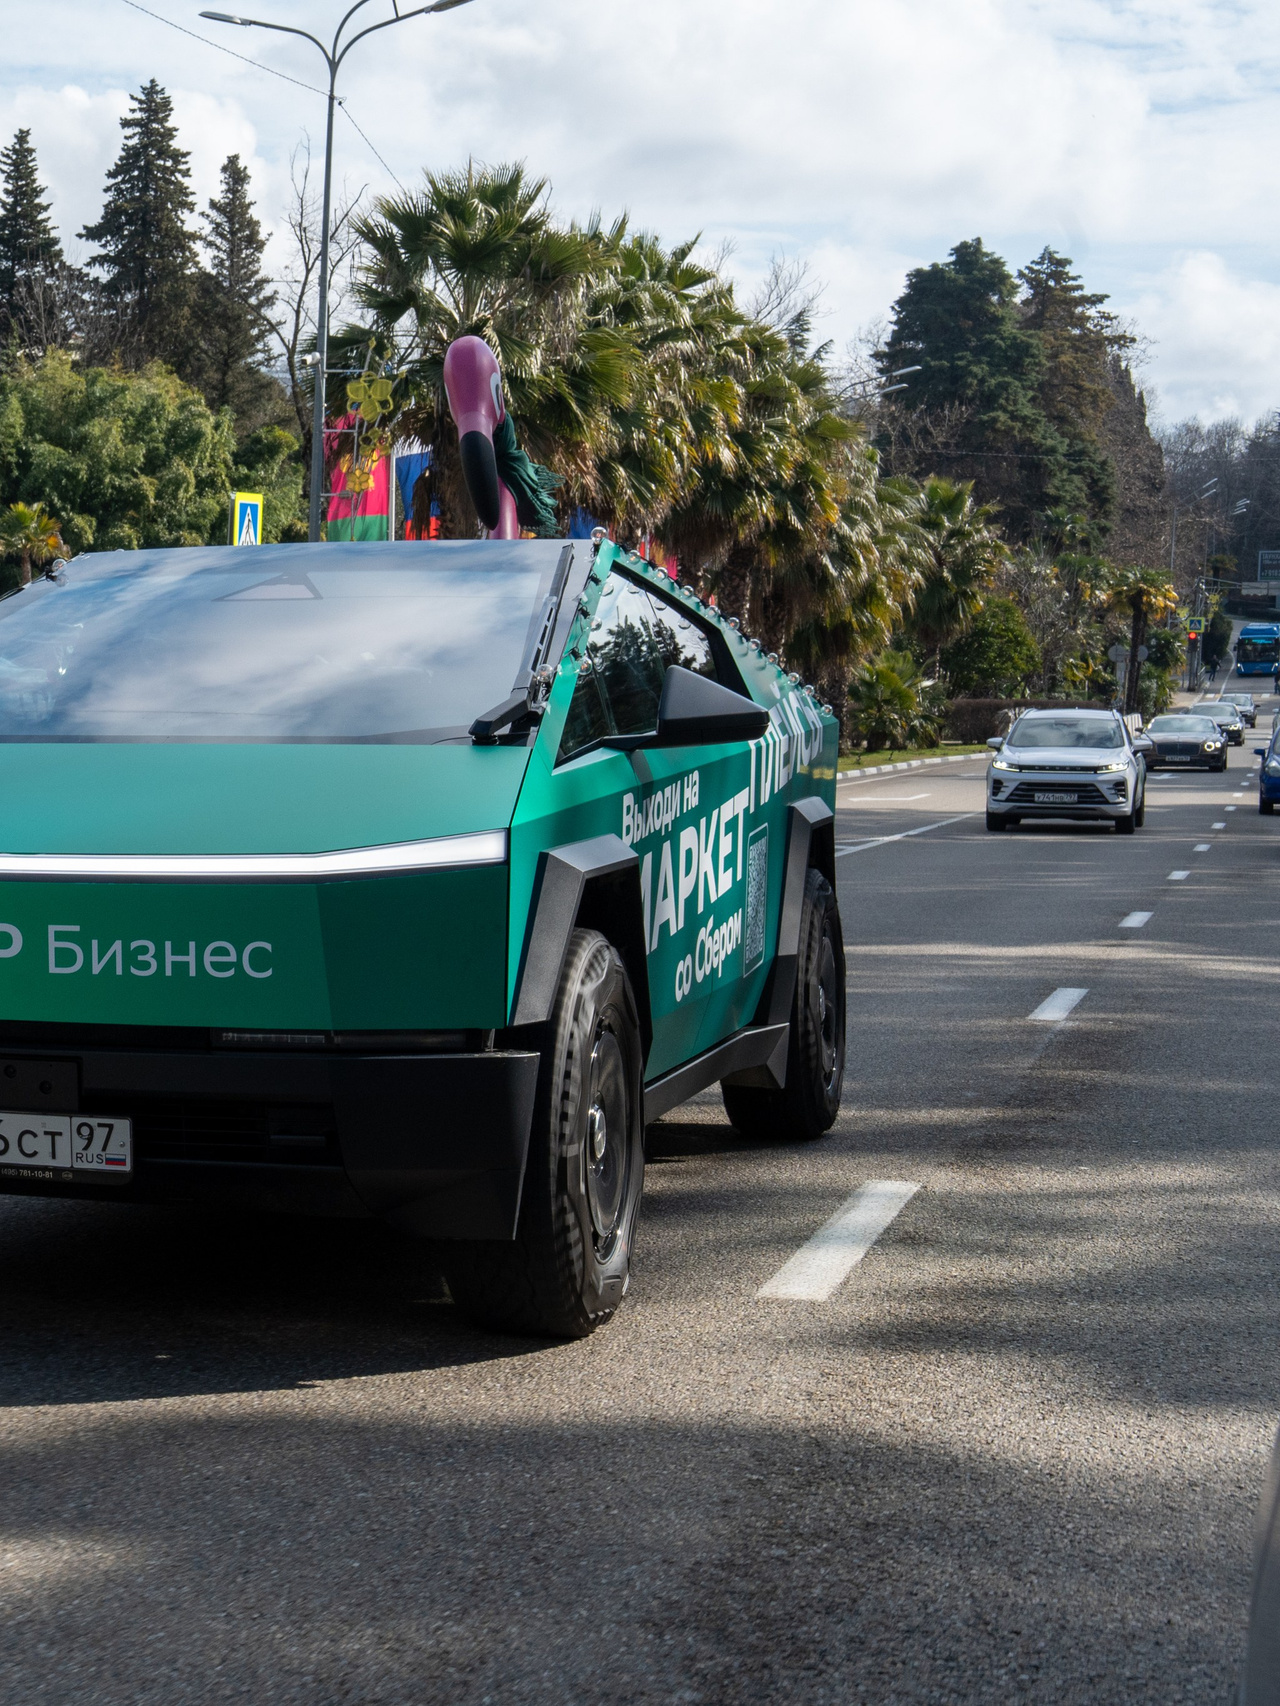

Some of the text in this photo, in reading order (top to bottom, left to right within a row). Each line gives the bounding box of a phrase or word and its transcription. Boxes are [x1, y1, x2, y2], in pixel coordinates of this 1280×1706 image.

[622, 770, 700, 848] Выходи на
[46, 924, 273, 979] Бизнес
[675, 908, 742, 1002] со Сбером
[76, 1121, 115, 1152] 97
[19, 1169, 53, 1178] 781-10-81
[75, 1152, 104, 1165] RUS
